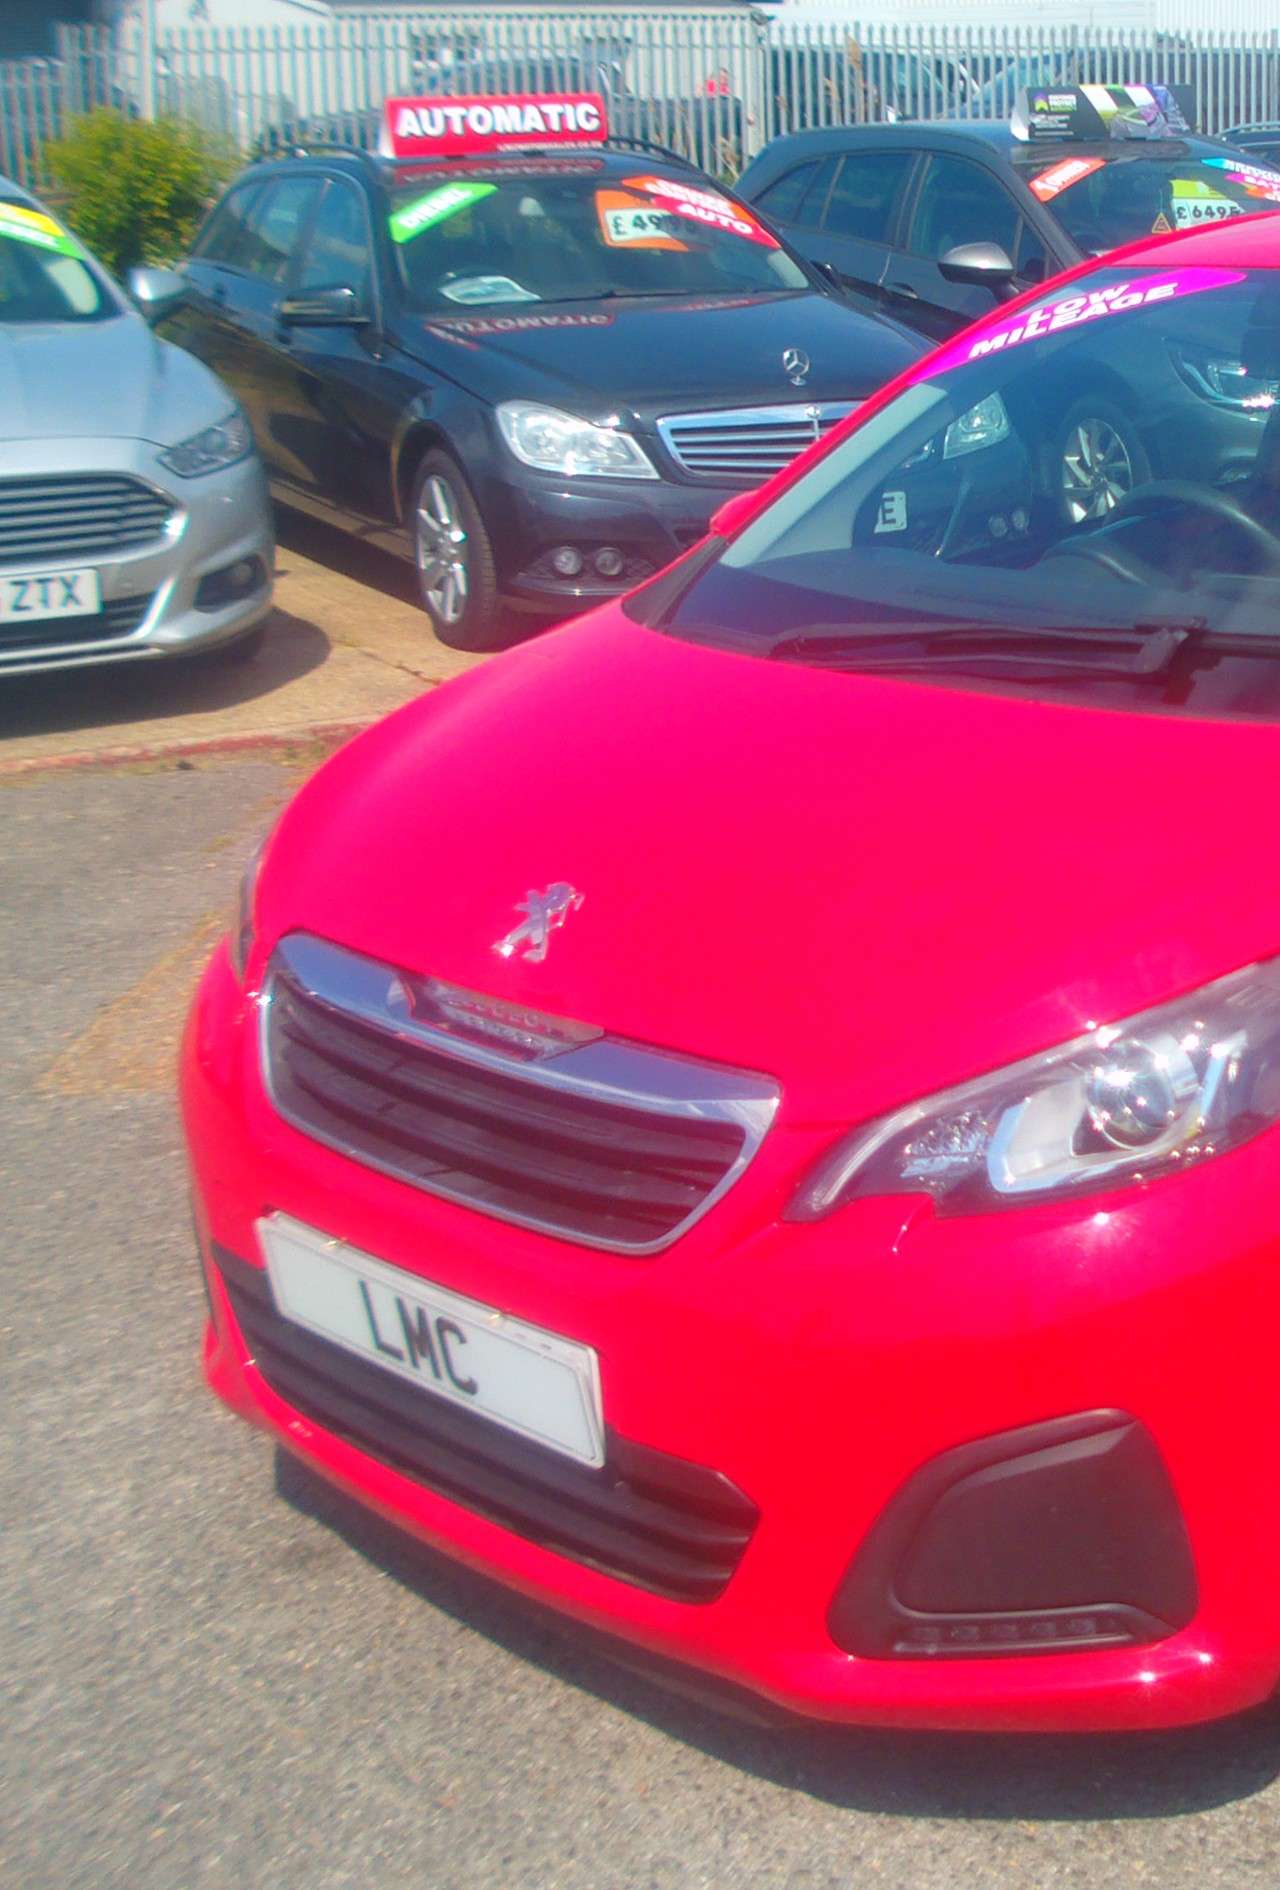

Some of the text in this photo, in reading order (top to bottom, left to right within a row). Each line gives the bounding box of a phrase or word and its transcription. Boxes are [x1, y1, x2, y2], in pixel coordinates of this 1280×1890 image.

[397, 103, 601, 137] AUTOMATIC
[968, 282, 1178, 359] MILEAGE
[1027, 284, 1130, 326] LOW
[9, 576, 83, 612] ZTX
[358, 1279, 479, 1396] LMC
